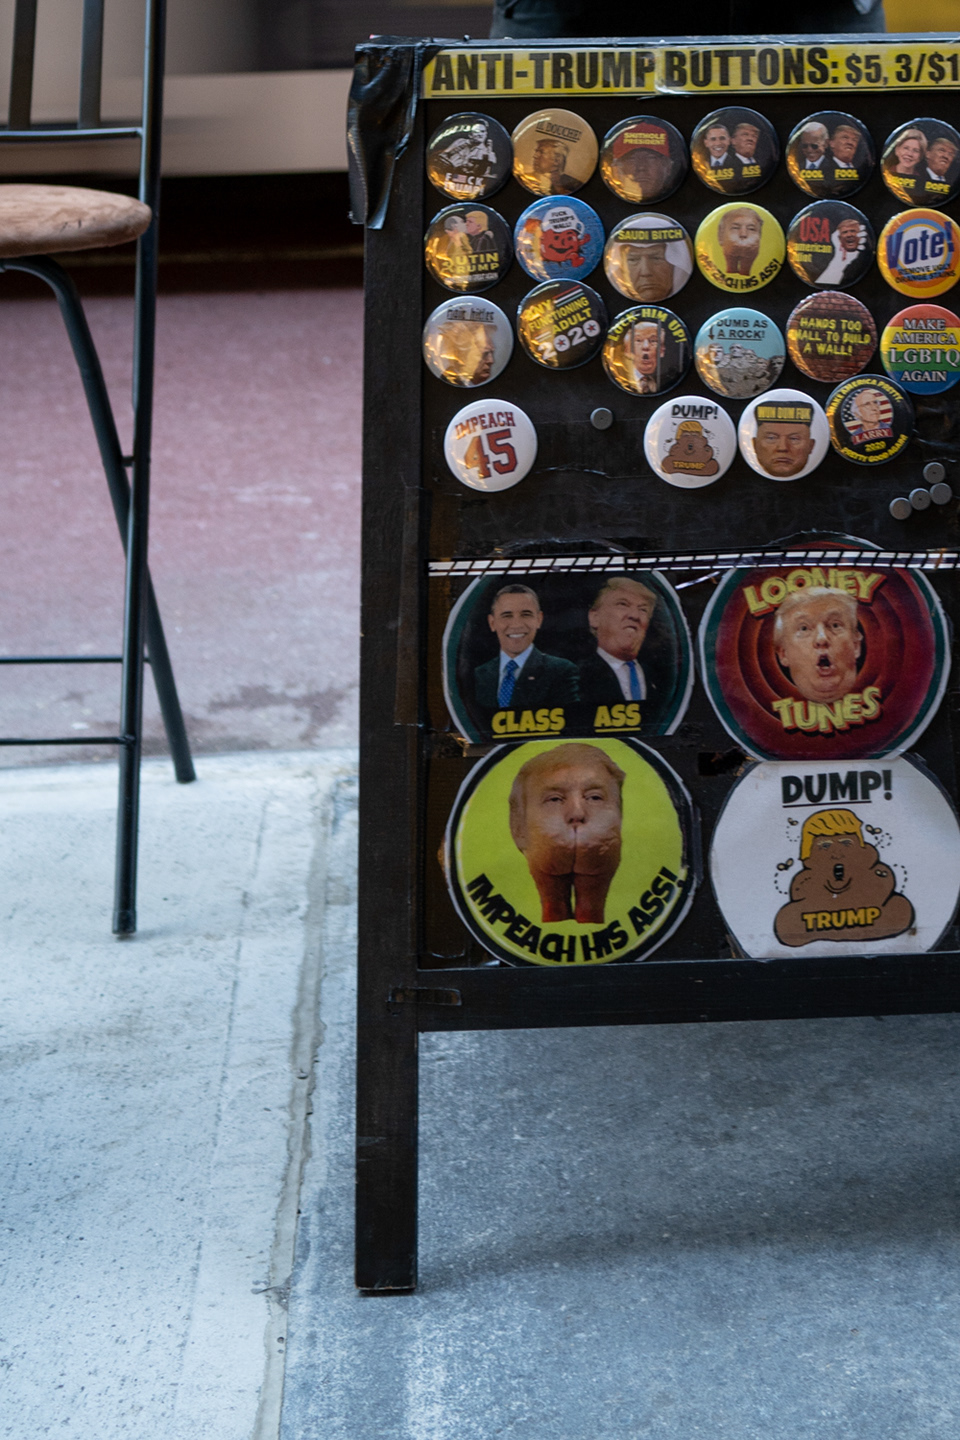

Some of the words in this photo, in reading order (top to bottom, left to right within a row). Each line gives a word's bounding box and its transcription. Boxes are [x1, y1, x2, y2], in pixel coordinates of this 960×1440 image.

[432, 51, 655, 91] ANTI-TRUMP
[664, 47, 839, 88] BUTTONS:
[845, 53, 889, 87] $5,
[623, 132, 666, 140] SHITHOLE
[623, 138, 665, 146] PRESIDENT
[742, 165, 761, 176] ASS
[800, 169, 824, 179] COOL
[835, 169, 859, 179] FOOL
[925, 181, 951, 193] DOPE
[618, 230, 649, 241] SAUDI
[651, 229, 683, 240] BITCH
[801, 216, 830, 242] USA
[886, 221, 954, 270] Vote!
[740, 276, 759, 289] HIS
[759, 258, 783, 283] ASS!
[529, 297, 590, 332] FUNCTIONING
[552, 307, 592, 334] ADULT
[608, 314, 637, 342] LOCK
[642, 308, 668, 322] HIM
[668, 317, 687, 343] UP!
[716, 319, 749, 328] DUMB
[752, 319, 768, 328] AS
[800, 317, 836, 329] HANDS
[841, 319, 862, 331] TOO
[903, 319, 945, 331] MAKE
[538, 320, 601, 360] 2020
[717, 329, 726, 338] A
[728, 329, 765, 339] ROCK!
[826, 331, 840, 342] TO
[842, 332, 871, 344] BUILD
[891, 332, 957, 345] AMERICA
[803, 342, 812, 354] A
[816, 343, 853, 356] WALL!
[890, 347, 960, 368] LGBTQ
[901, 371, 947, 382] AGAIN
[842, 379, 877, 397] AMERICA
[671, 404, 718, 419] DUMP!
[455, 411, 516, 440] IMPEACH
[855, 428, 889, 442] LARRY
[464, 428, 518, 479] 45
[867, 452, 889, 462] GOOD
[673, 461, 705, 470] TRUMP
[743, 568, 886, 616] LOONEY
[772, 686, 882, 732] TUNES
[491, 707, 566, 735] CLASS
[593, 703, 642, 728] ASS
[781, 769, 893, 805] DUMP!
[466, 873, 576, 962] IMPEACH
[581, 920, 629, 962] HIS
[628, 866, 684, 936] ASS!
[802, 906, 882, 933] TRUMP
